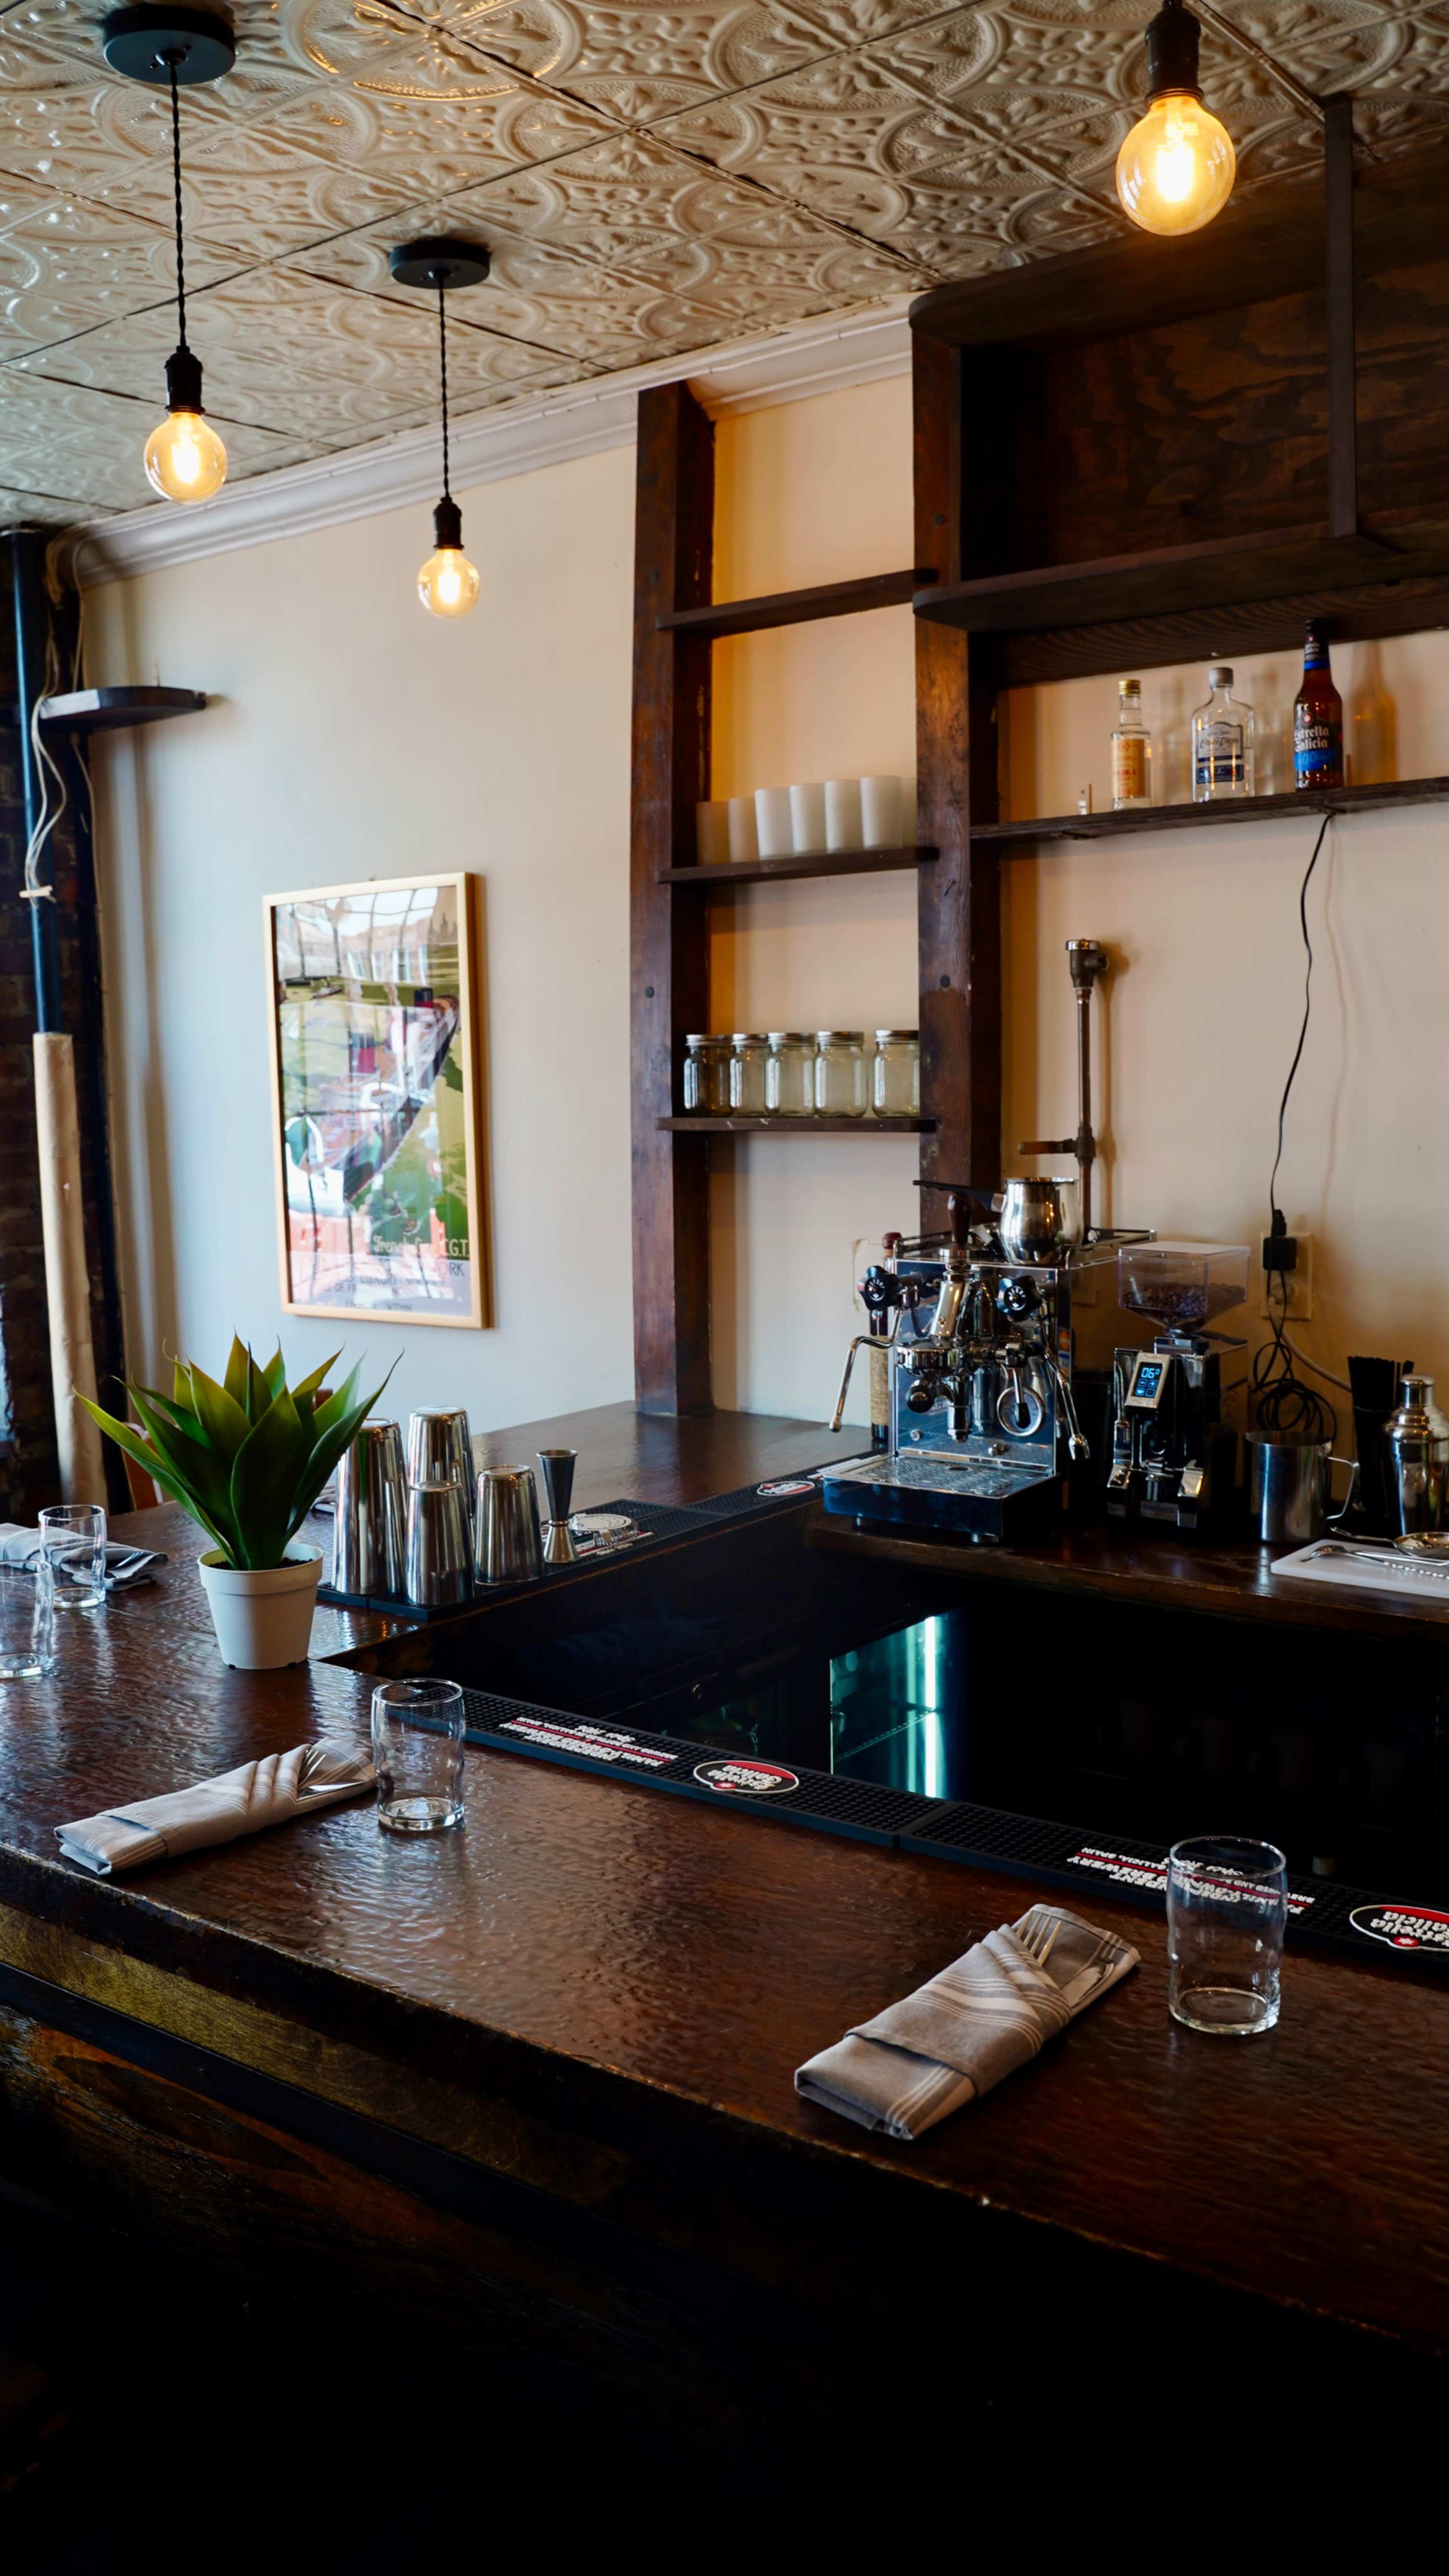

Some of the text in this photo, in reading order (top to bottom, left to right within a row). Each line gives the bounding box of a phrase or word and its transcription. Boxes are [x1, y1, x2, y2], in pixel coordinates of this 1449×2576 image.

[708, 1769, 775, 1790] Estrella
[722, 1765, 782, 1784] Galicia
[1081, 1847, 1117, 1859] SPAIN
[1067, 1856, 1157, 1880] BREWERY
